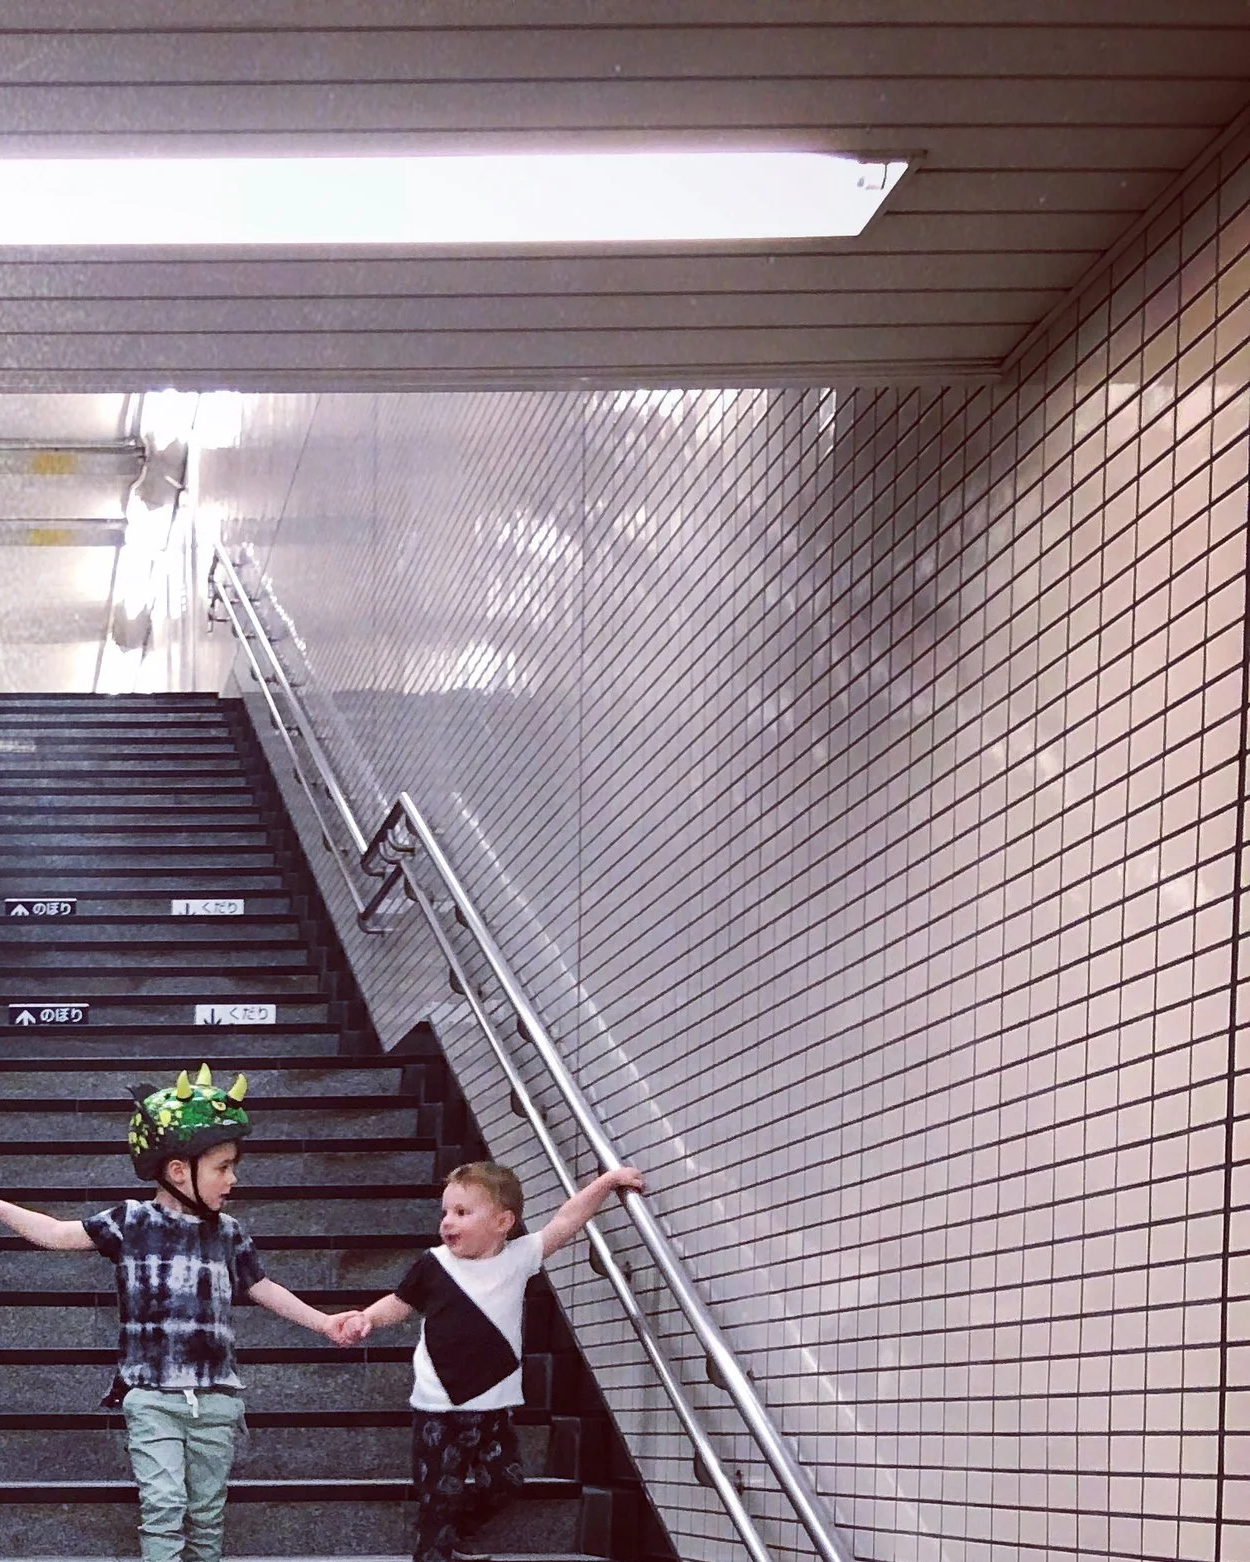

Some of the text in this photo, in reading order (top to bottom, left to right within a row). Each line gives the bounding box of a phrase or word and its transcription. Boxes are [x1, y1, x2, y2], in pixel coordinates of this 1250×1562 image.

[202, 902, 237, 915] くだり
[229, 1007, 268, 1020] くだり
